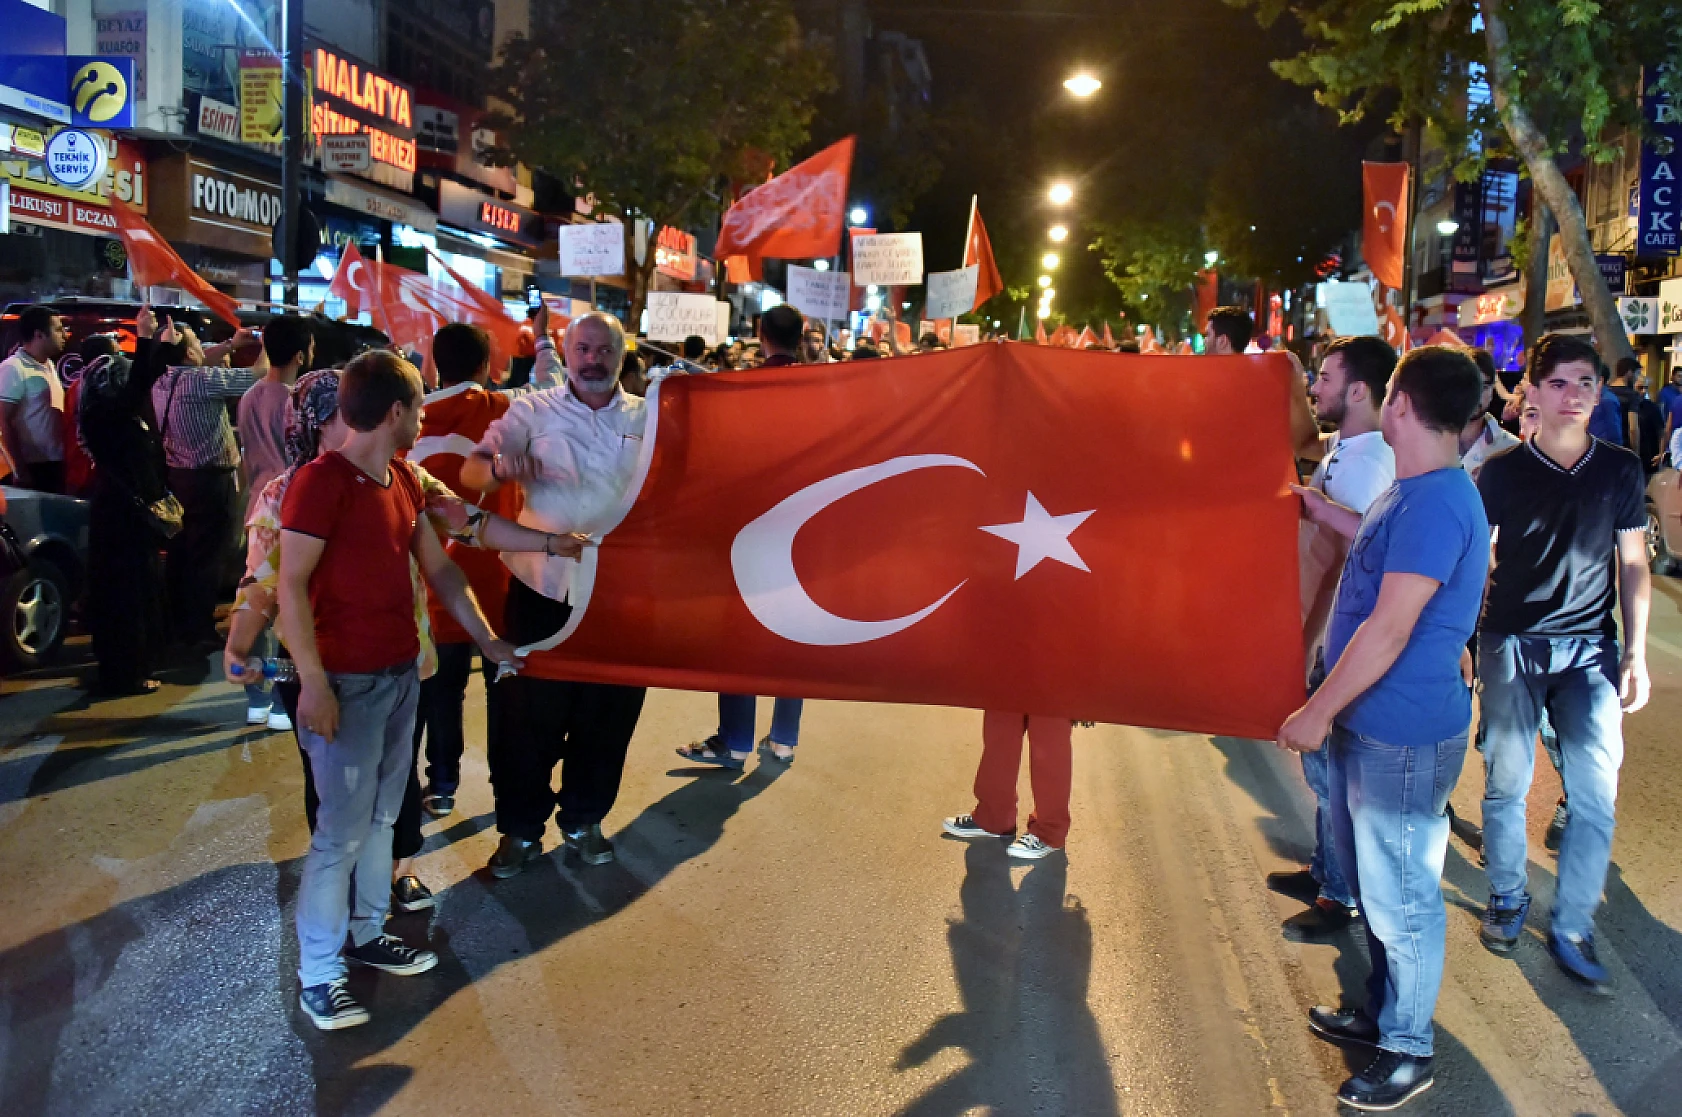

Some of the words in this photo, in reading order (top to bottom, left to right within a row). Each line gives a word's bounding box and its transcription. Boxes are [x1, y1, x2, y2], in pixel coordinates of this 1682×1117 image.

[316, 48, 411, 129] MALATYA
[54, 151, 91, 161] TEKNİK
[54, 163, 89, 174] SERVİS
[193, 173, 238, 217] FOTO
[10, 193, 63, 218] LIKUŞU
[75, 207, 118, 228] ECZAN
[1644, 232, 1676, 245] CAFE
